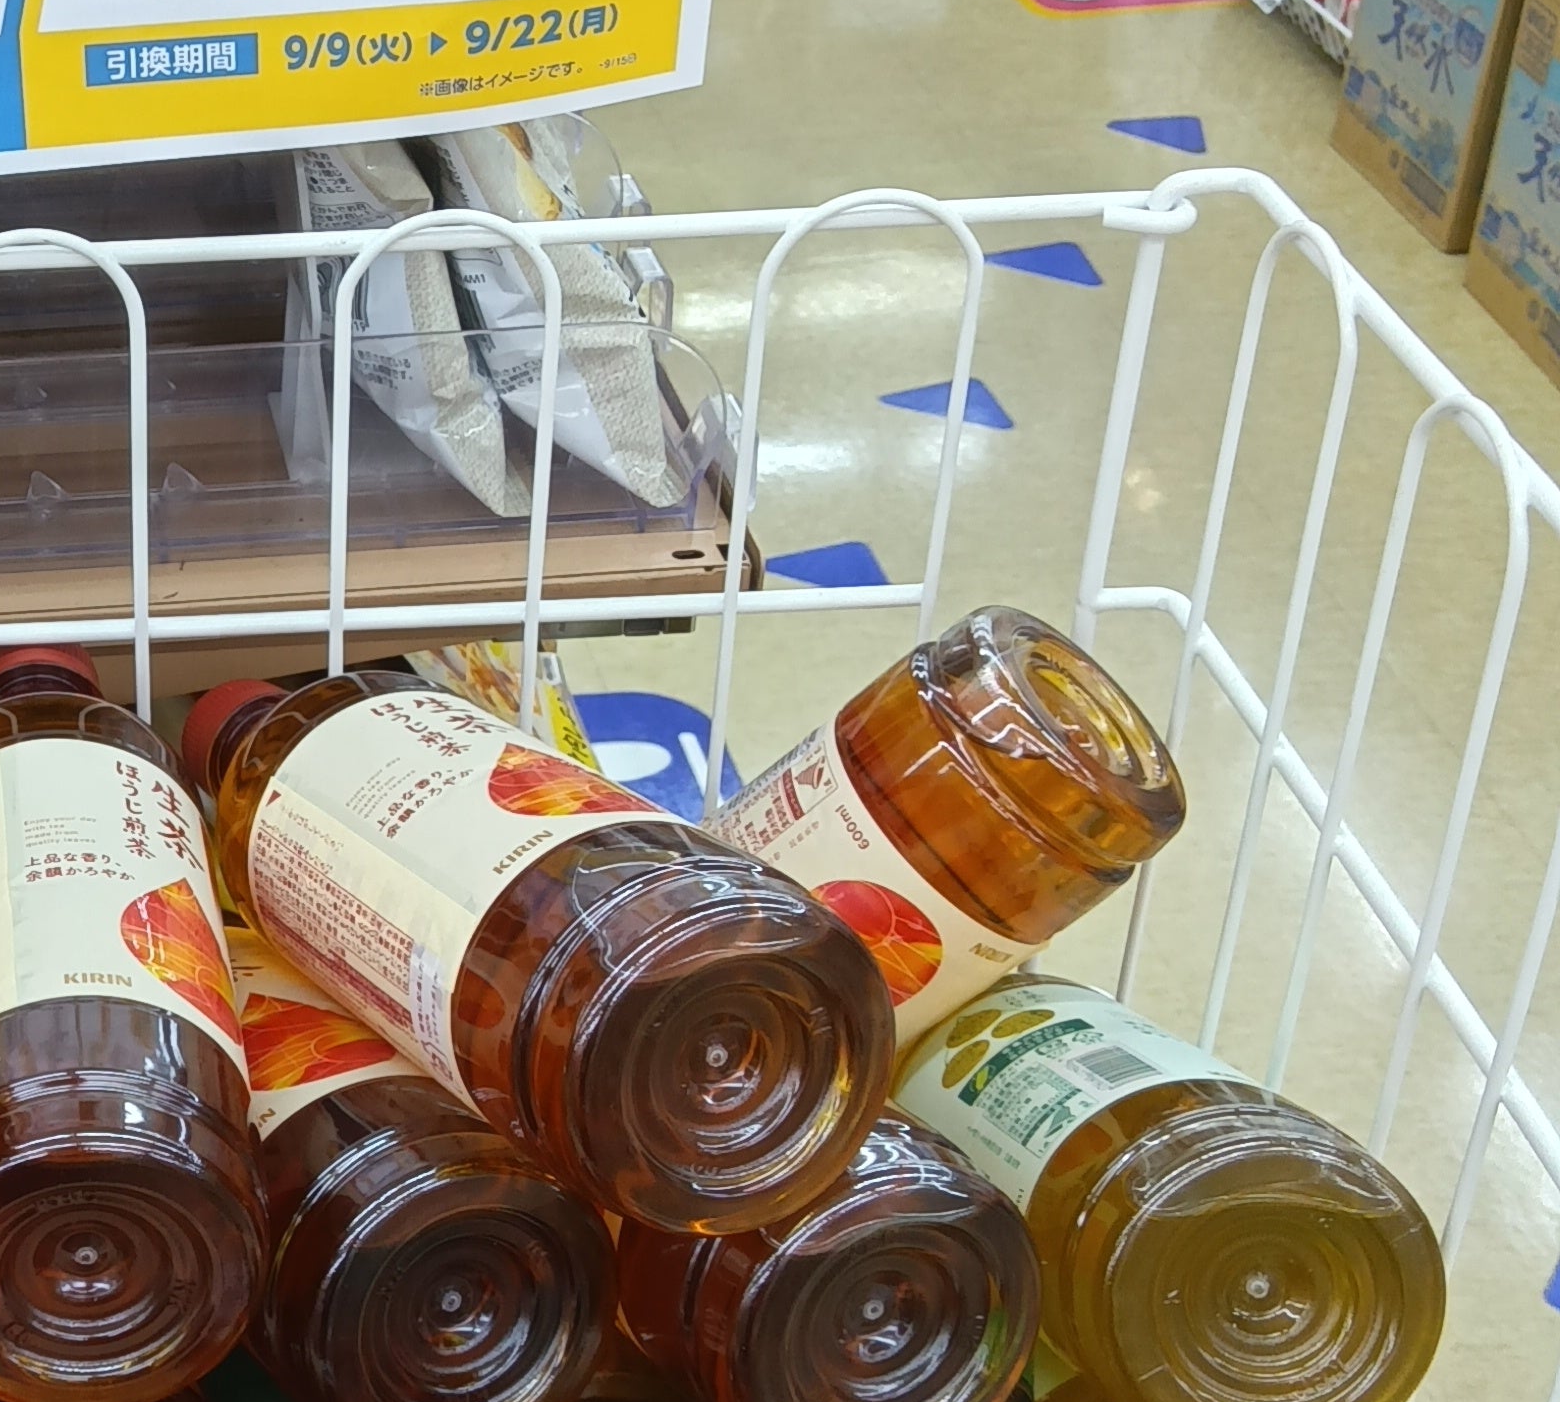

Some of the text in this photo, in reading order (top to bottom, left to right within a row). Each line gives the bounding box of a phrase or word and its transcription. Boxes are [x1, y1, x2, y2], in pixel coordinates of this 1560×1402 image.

[105, 4, 618, 80] 引換期間 9/9(火) 9/22(月)
[420, 61, 583, 96] ※画像はイメージです。
[370, 702, 472, 757] ほうじ煎茶
[412, 696, 512, 736] 生茶
[116, 761, 156, 860] ほうじ煎茶
[376, 770, 456, 833] 上品な香り、
[386, 768, 474, 839] 余韻かろやか
[151, 780, 205, 872] 生茶
[834, 805, 870, 851] 600ml
[25, 852, 122, 868] 上品な香り、
[25, 866, 135, 882] 余韻かろやか
[492, 829, 554, 876] KIRIN
[969, 942, 1013, 965] KIRIN
[64, 972, 132, 987] KIRIN
